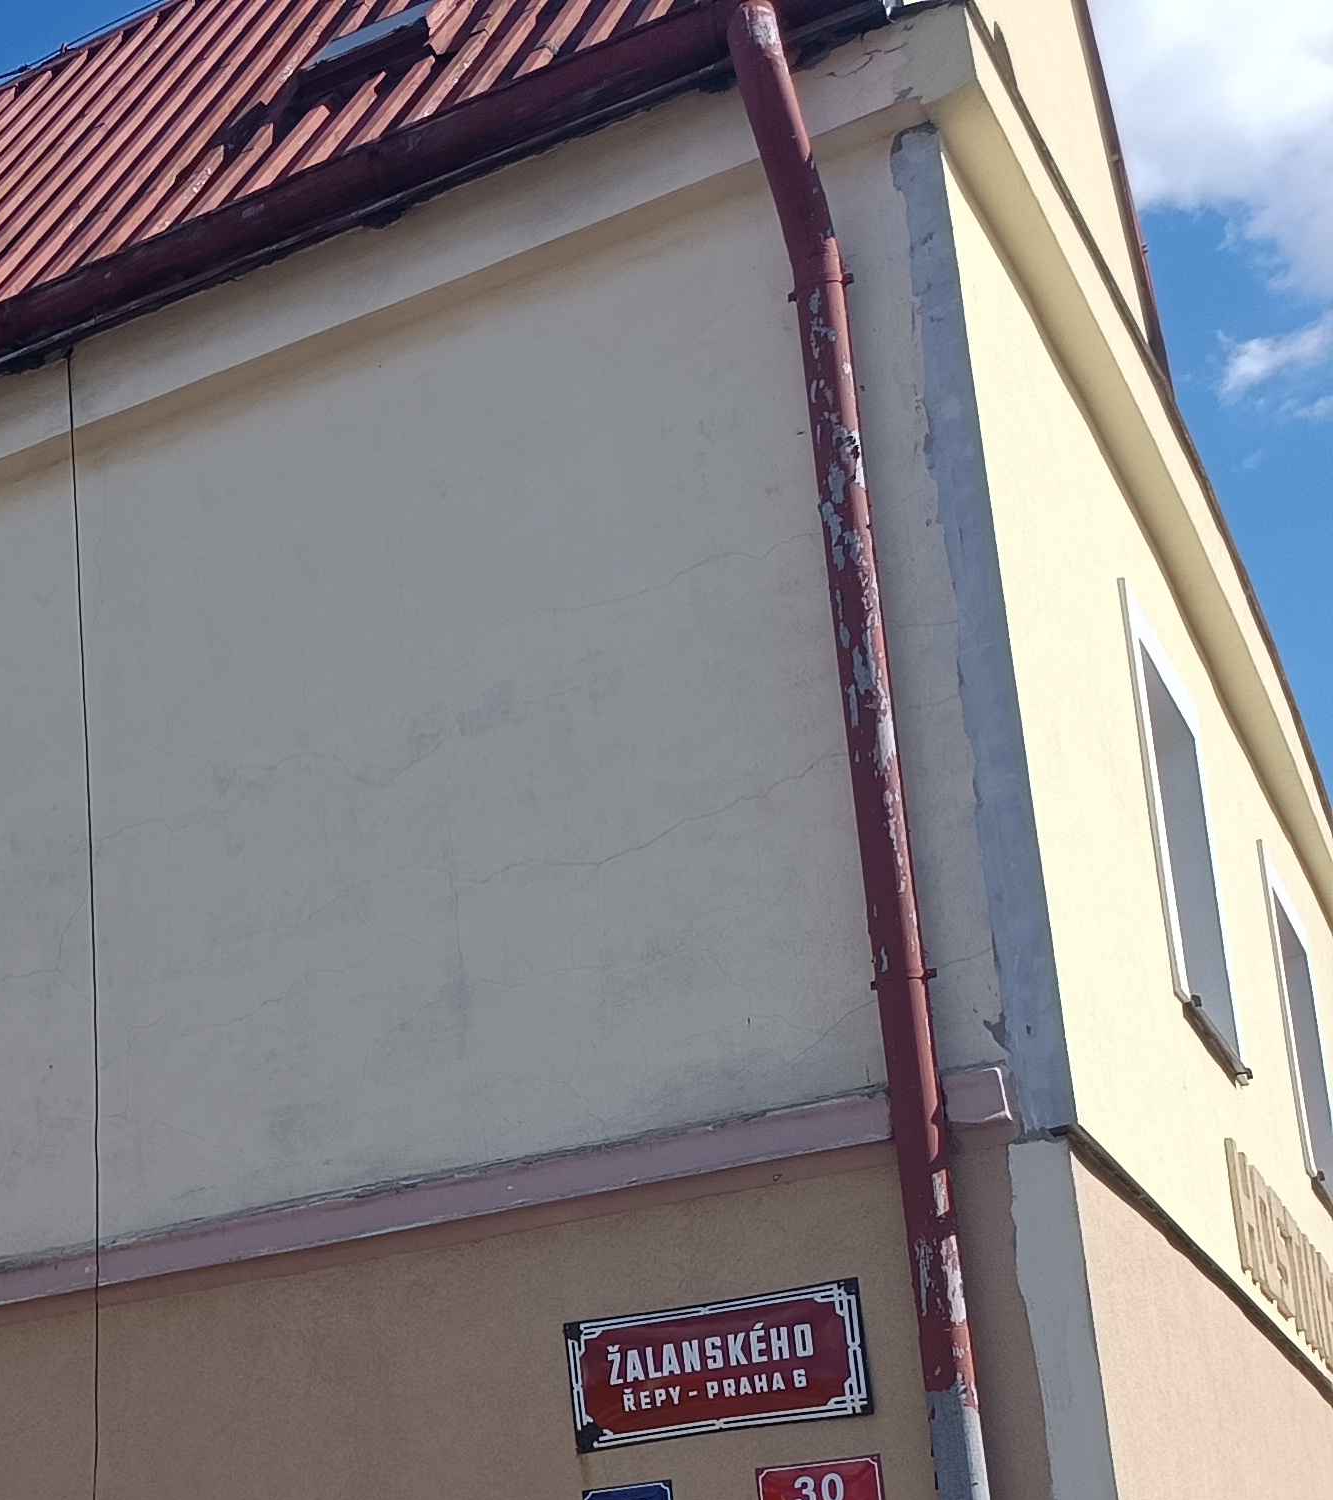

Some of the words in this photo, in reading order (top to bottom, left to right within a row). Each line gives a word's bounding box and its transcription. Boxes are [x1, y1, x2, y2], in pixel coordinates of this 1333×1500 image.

[606, 1322, 814, 1386] ŽALANSKÉHO
[622, 1385, 681, 1412] ŘEPY
[705, 1371, 786, 1399] PRAHA
[792, 1368, 808, 1388] 6
